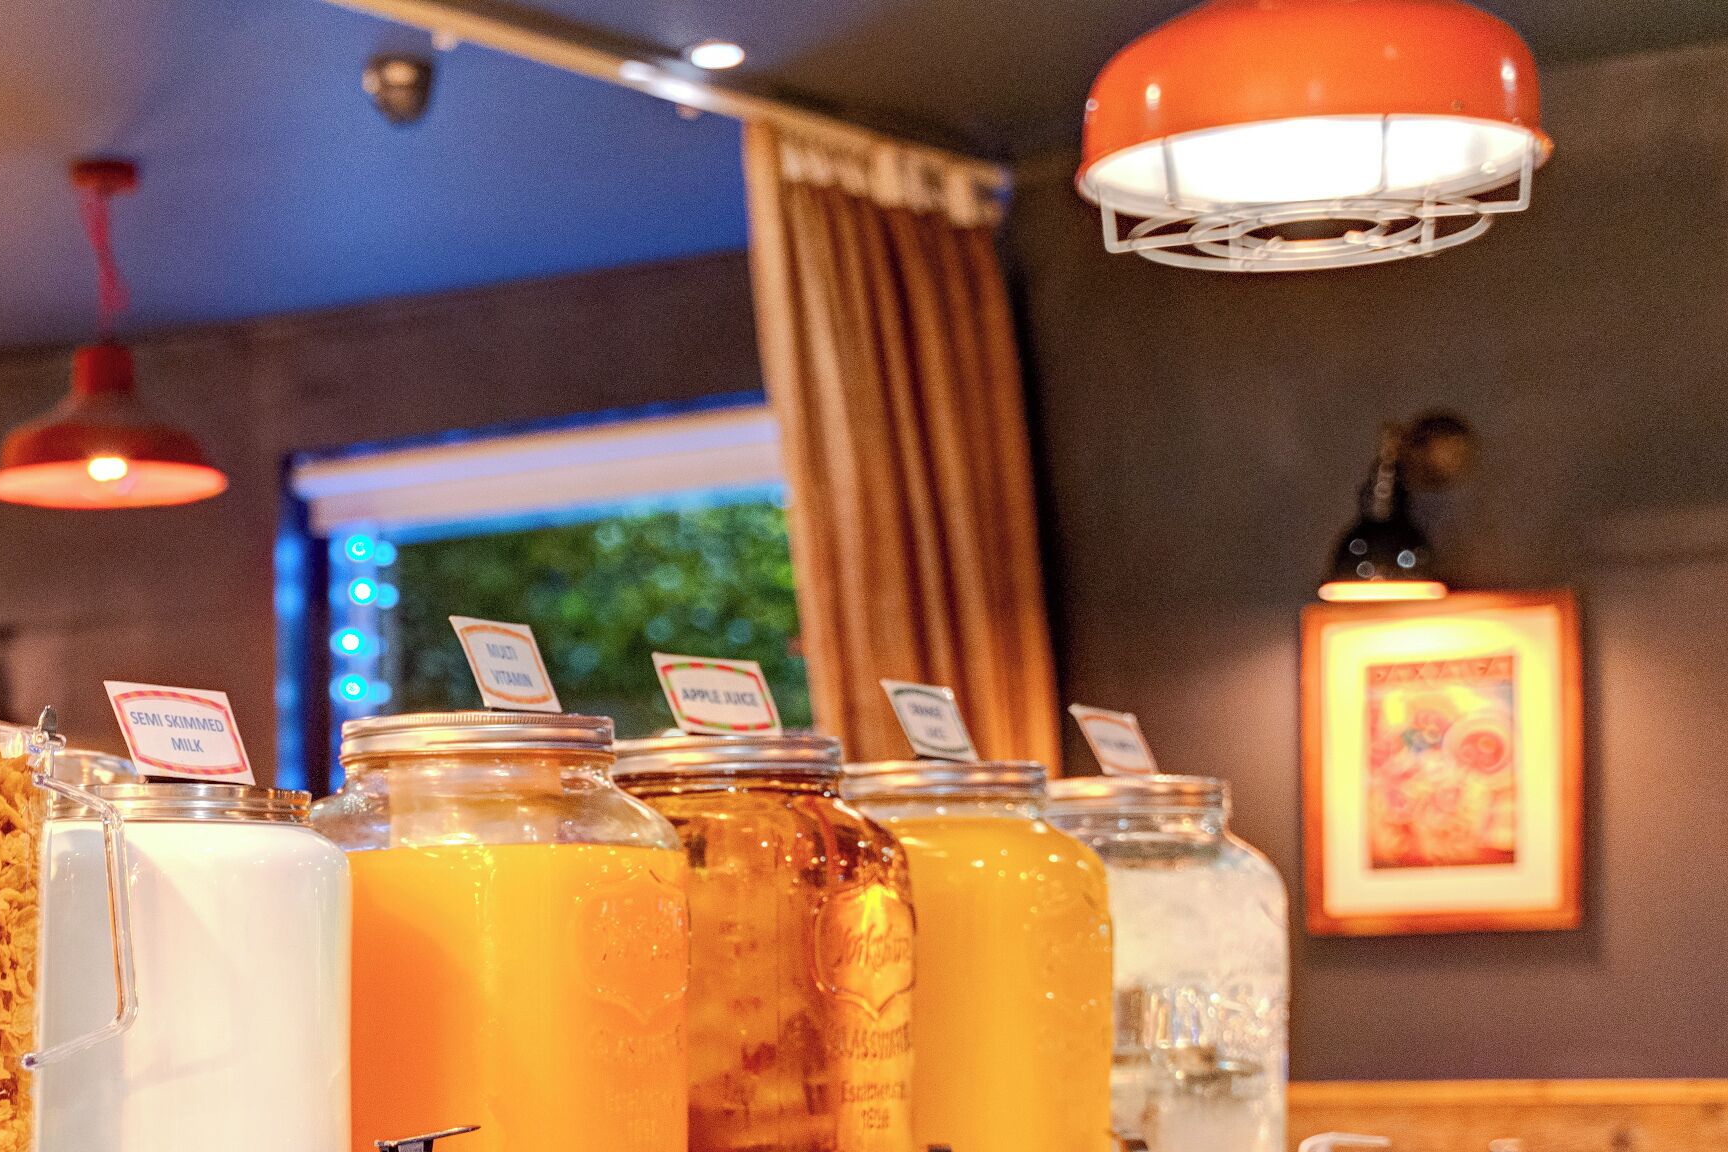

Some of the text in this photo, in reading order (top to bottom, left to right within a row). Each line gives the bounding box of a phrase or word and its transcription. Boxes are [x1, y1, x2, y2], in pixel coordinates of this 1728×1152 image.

[681, 687, 721, 705] APPLE
[129, 711, 225, 733] SEMI SKIMMED
[170, 737, 204, 753] MILK
